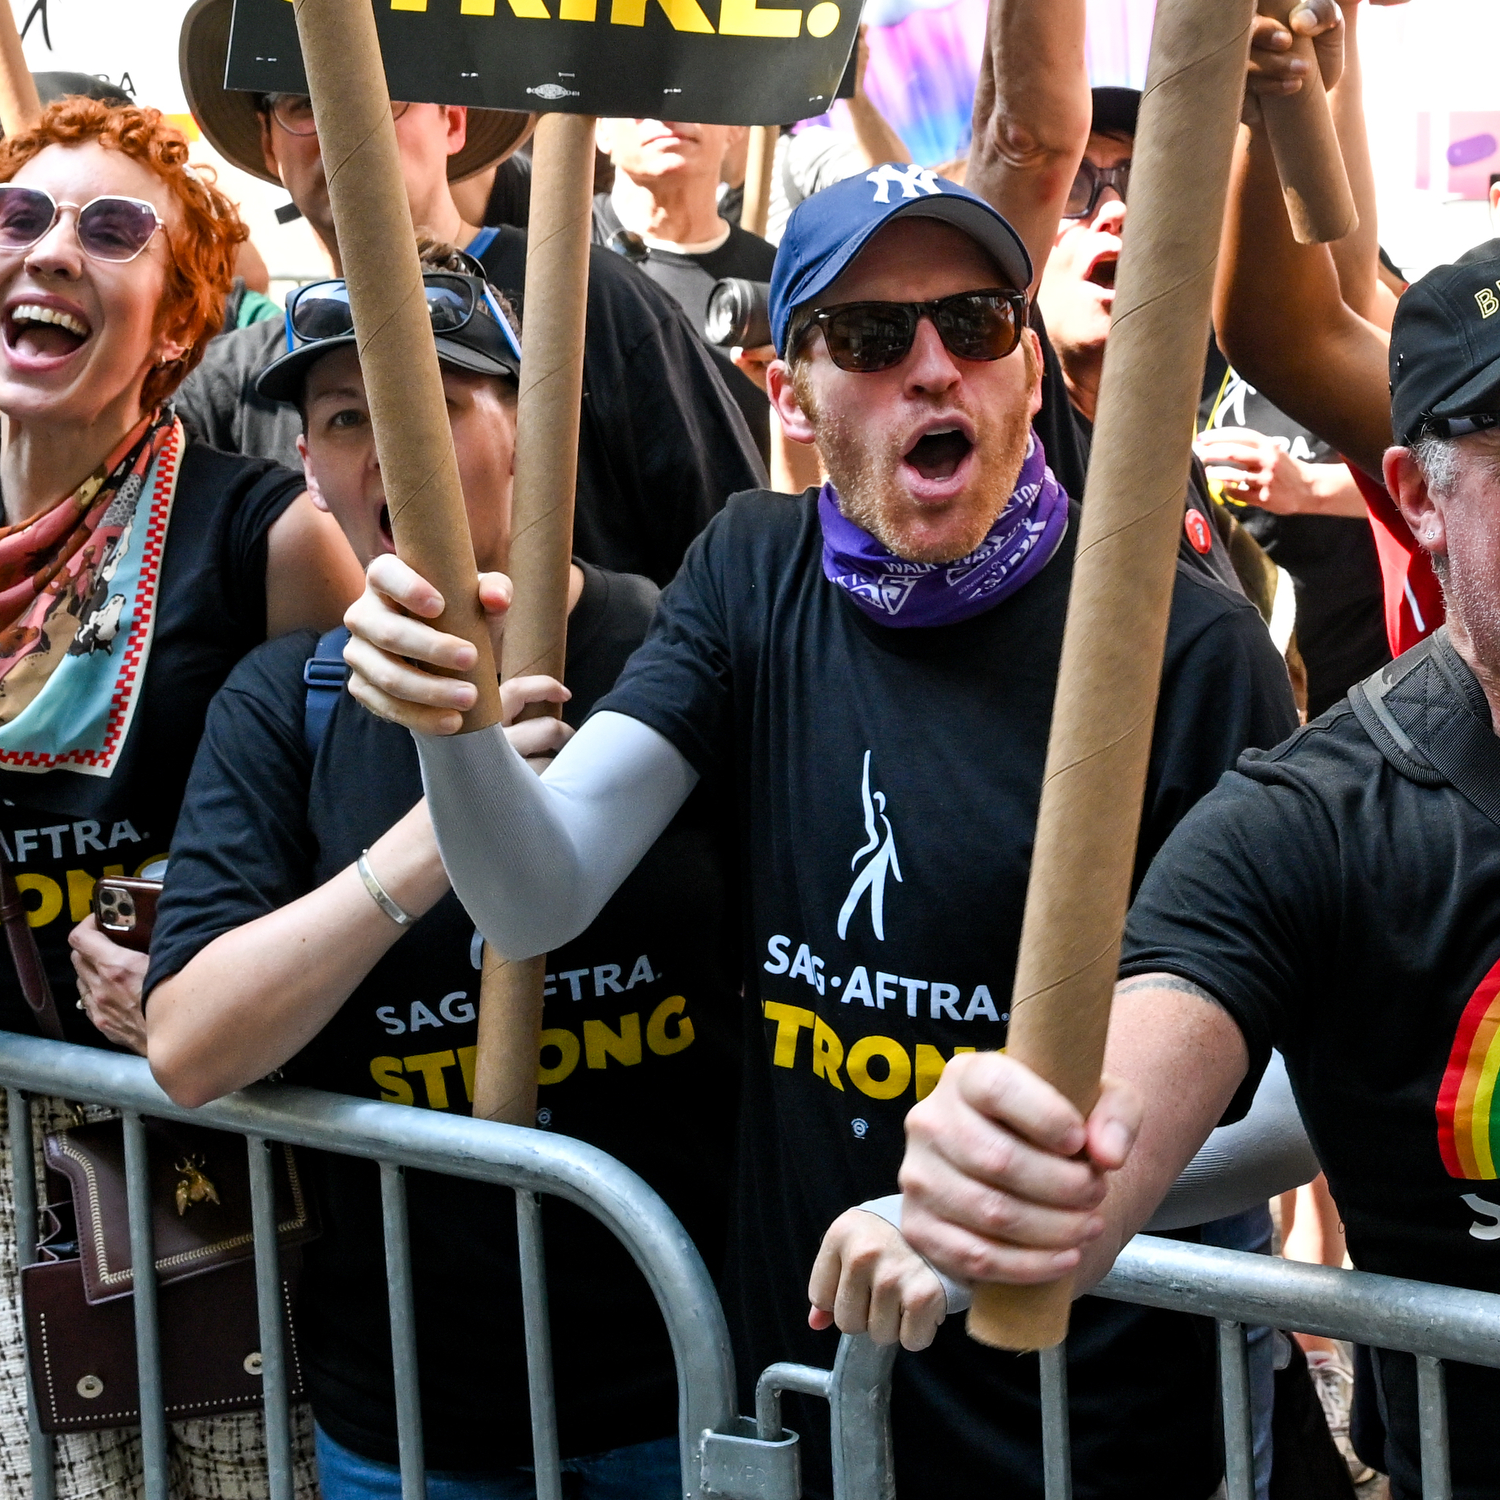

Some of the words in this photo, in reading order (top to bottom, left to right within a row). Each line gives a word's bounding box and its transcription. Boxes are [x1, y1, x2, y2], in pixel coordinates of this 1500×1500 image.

[884, 561, 939, 574] WALK
[375, 954, 663, 1036] SAGTRA
[762, 1000, 1007, 1102] TRON
